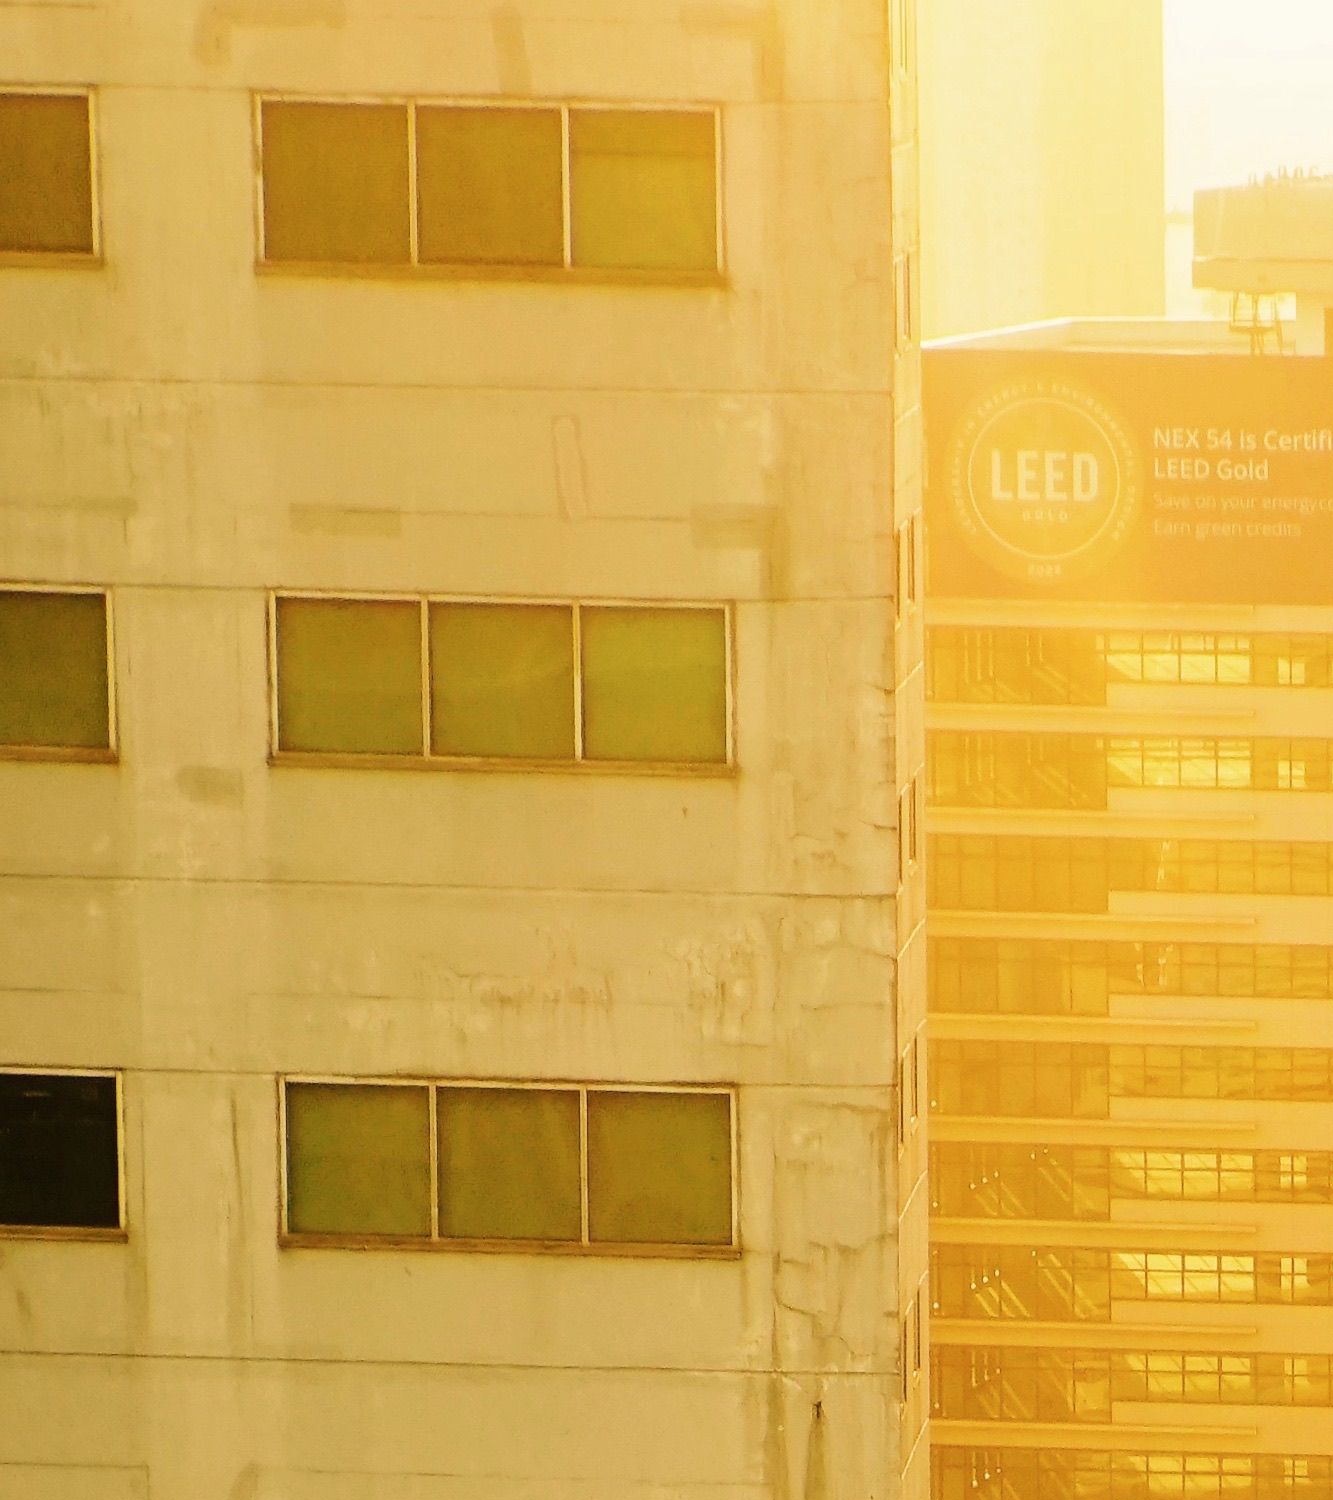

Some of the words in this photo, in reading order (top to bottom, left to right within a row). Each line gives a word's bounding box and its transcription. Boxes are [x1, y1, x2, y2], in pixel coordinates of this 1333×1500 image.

[1152, 427, 1201, 449] NEX
[1206, 427, 1233, 450] 54
[990, 447, 1099, 502] LEED
[1152, 457, 1210, 480] LEED
[1216, 457, 1270, 481] Gold
